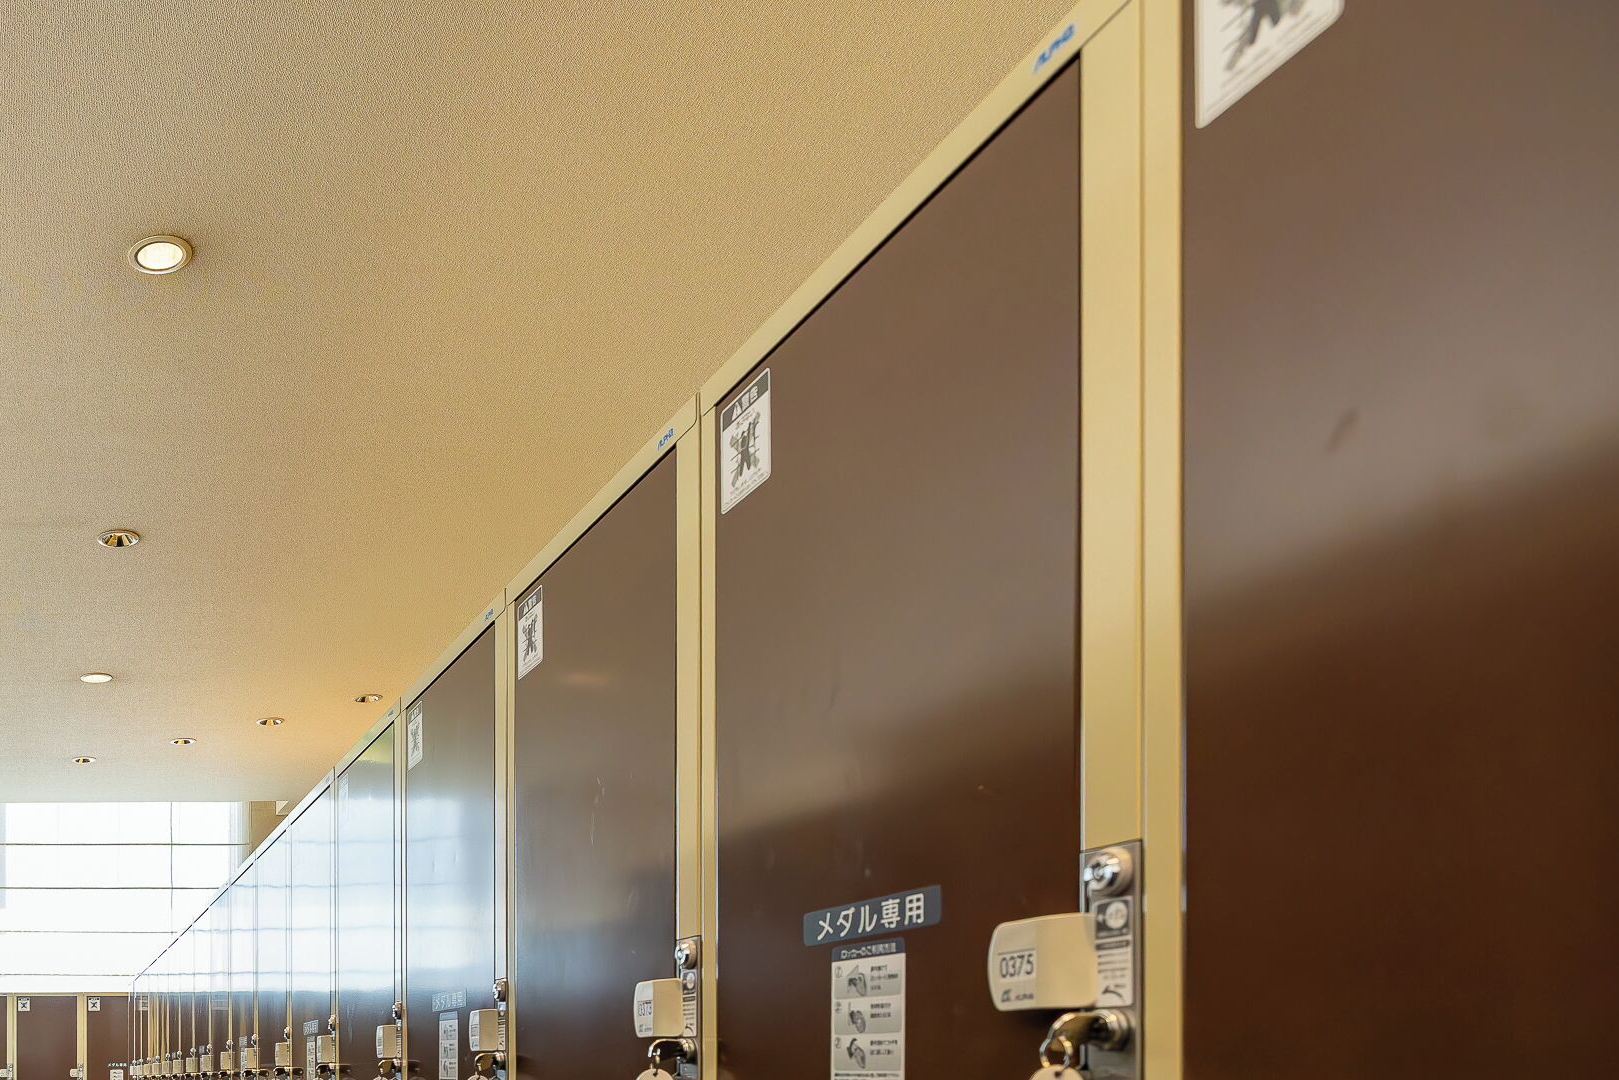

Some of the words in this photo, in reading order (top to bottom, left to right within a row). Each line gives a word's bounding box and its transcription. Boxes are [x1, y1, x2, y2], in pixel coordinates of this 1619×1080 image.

[817, 892, 925, 941] メダル専用
[999, 953, 1035, 979] 0375
